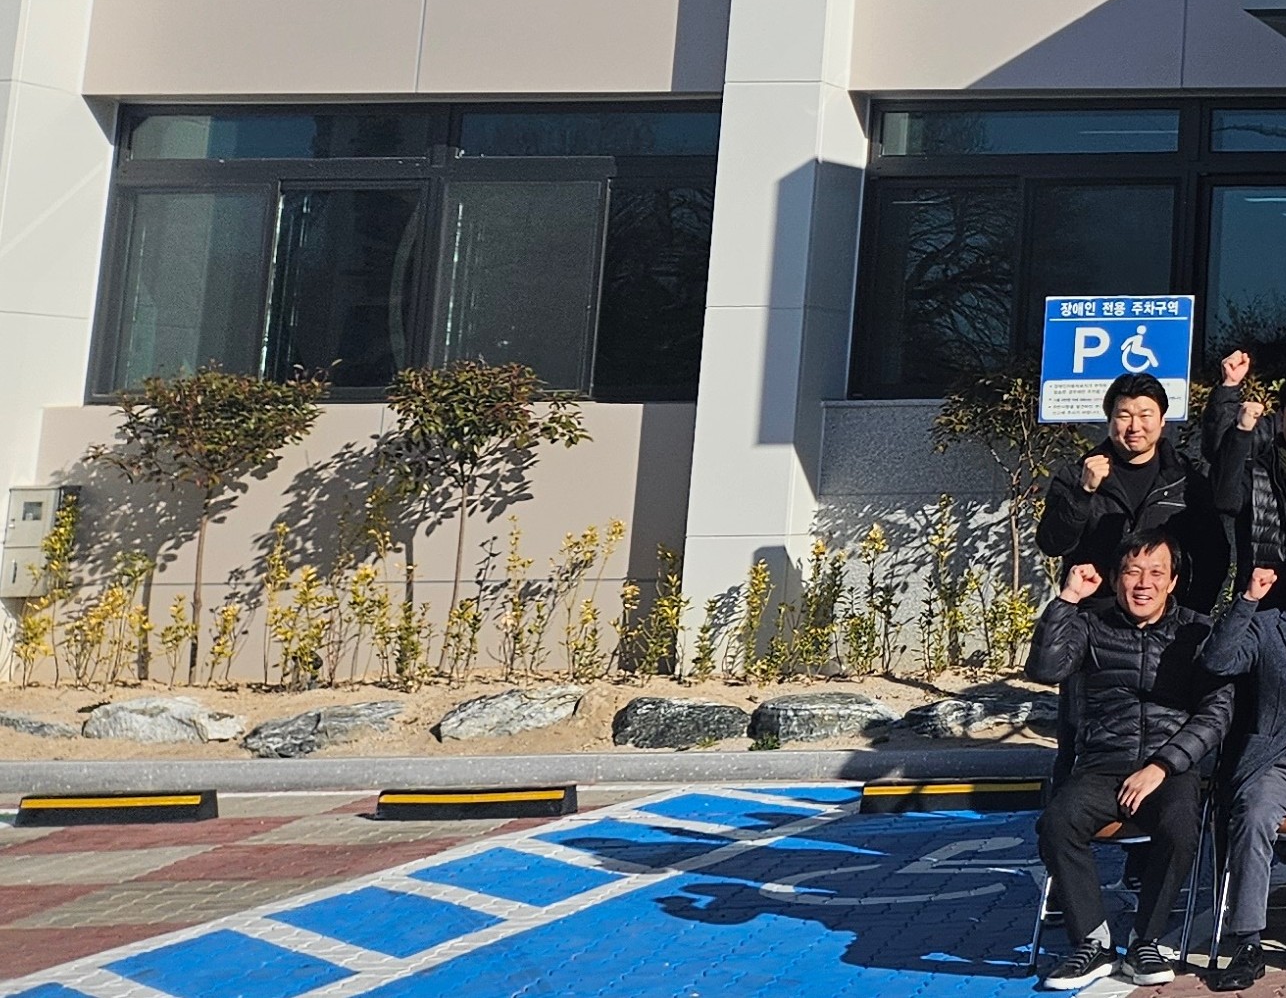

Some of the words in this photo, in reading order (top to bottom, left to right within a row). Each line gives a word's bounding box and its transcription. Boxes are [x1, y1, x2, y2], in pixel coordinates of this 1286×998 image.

[1060, 301, 1096, 317] 장애인
[1102, 301, 1126, 316] 전용
[1131, 300, 1179, 315] 주차구역
[1073, 326, 1111, 374] P
